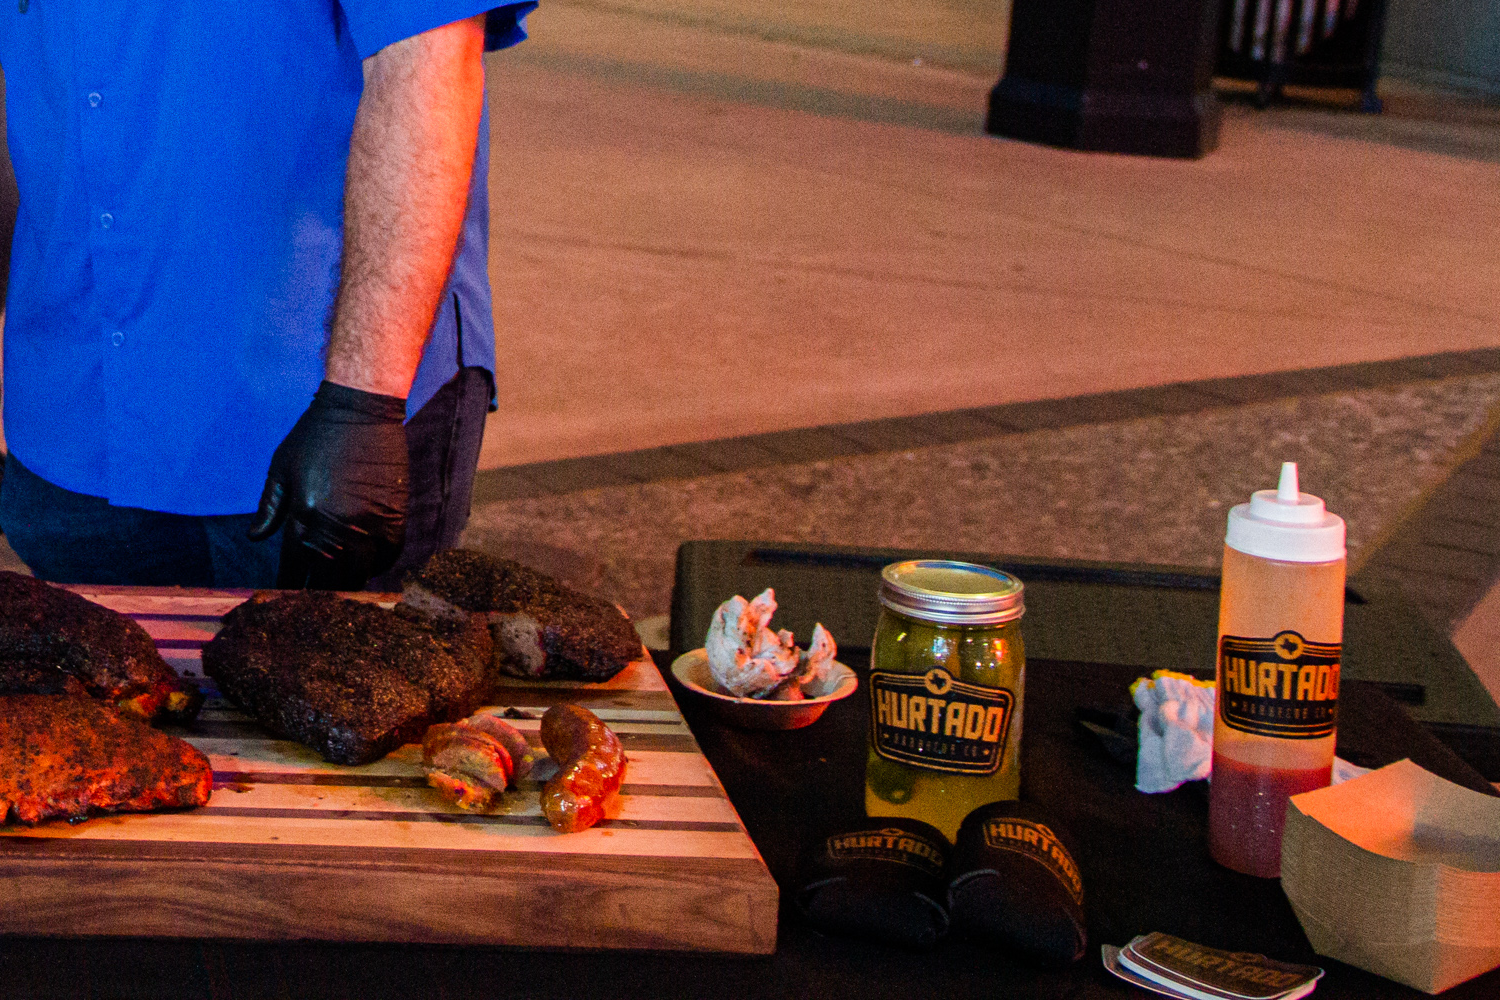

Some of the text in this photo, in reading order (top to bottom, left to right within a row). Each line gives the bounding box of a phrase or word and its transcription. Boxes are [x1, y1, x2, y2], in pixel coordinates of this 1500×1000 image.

[1225, 655, 1341, 701] HURTADO
[876, 688, 1004, 743] HURTADO
[834, 836, 943, 866] HURTADO
[990, 824, 1081, 892] HURTADO
